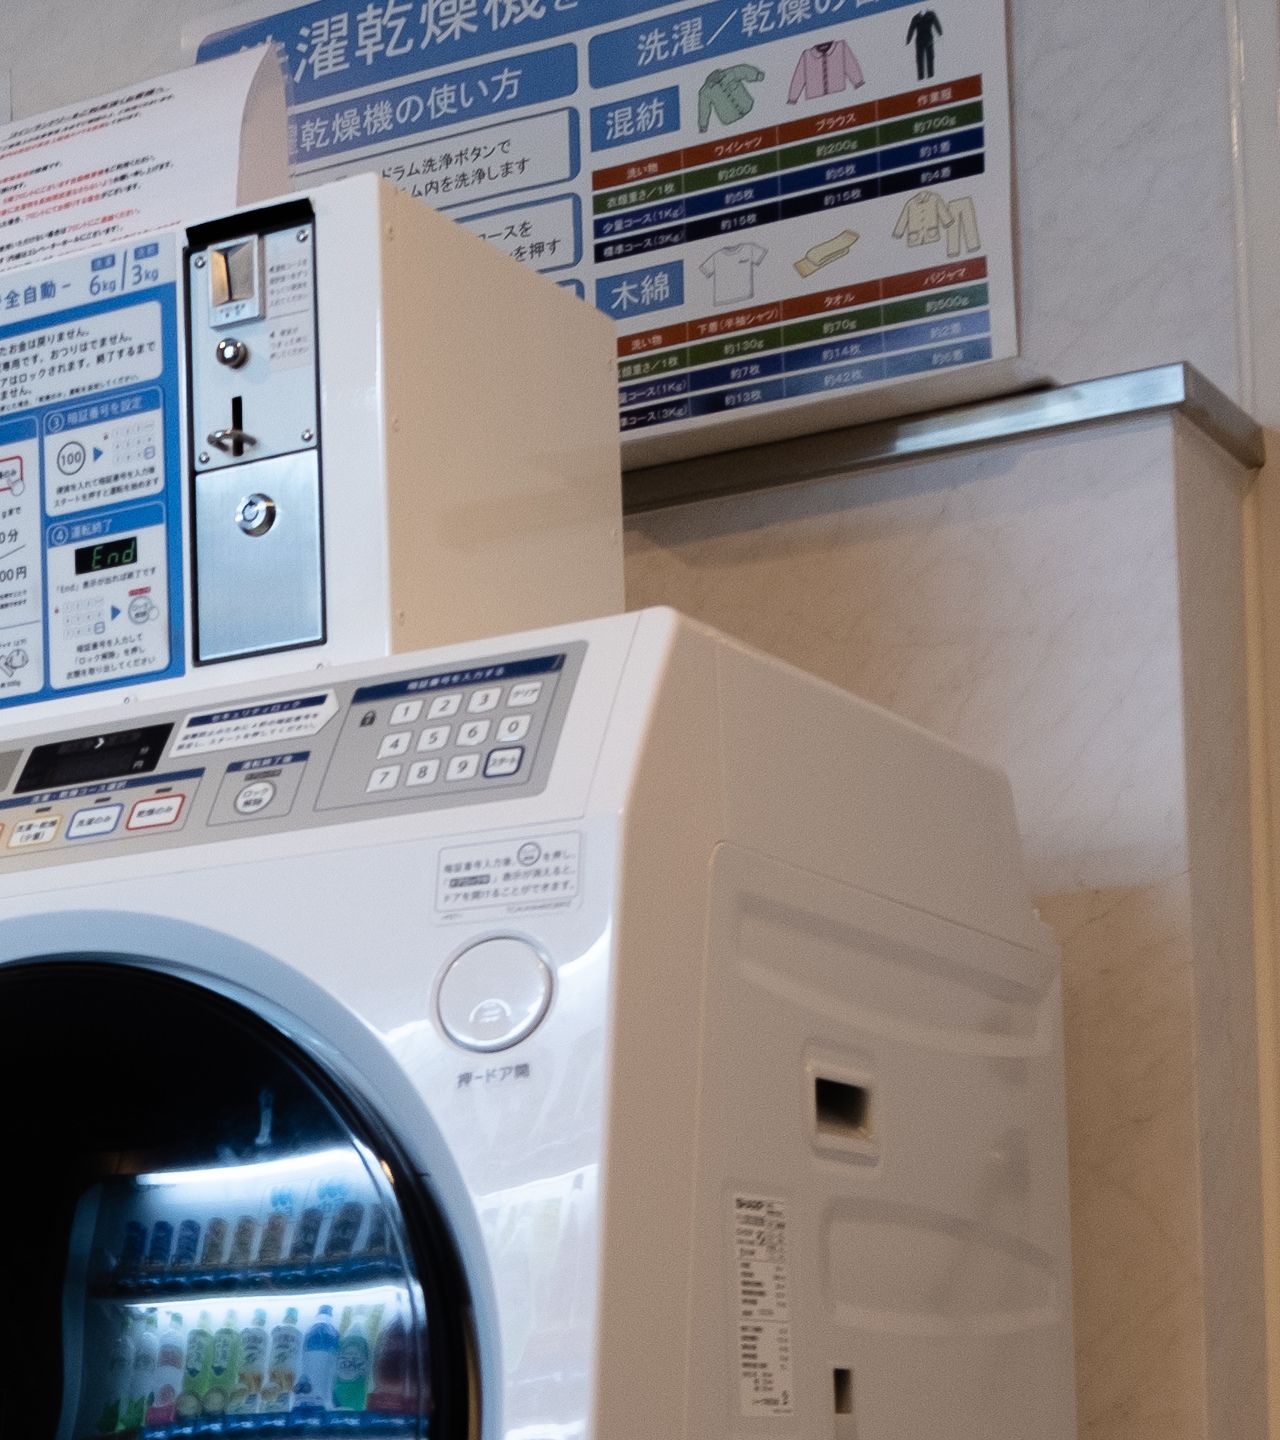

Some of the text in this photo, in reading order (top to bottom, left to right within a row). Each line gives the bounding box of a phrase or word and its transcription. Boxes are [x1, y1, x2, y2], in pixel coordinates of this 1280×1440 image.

[605, 97, 665, 140] 混紡
[816, 114, 856, 132] ブラウス
[89, 265, 159, 296] 6kg 3kg
[611, 271, 670, 311] 木綿
[61, 452, 82, 466] 100
[92, 541, 135, 570] End
[438, 699, 450, 711] 2
[479, 693, 489, 706] 3
[401, 707, 411, 719] 1
[468, 726, 478, 738] 6
[507, 721, 519, 734] 0
[389, 738, 400, 751] 4
[428, 732, 438, 745] 5
[417, 766, 428, 779] 8
[457, 760, 468, 774] 9
[378, 770, 389, 784] 7
